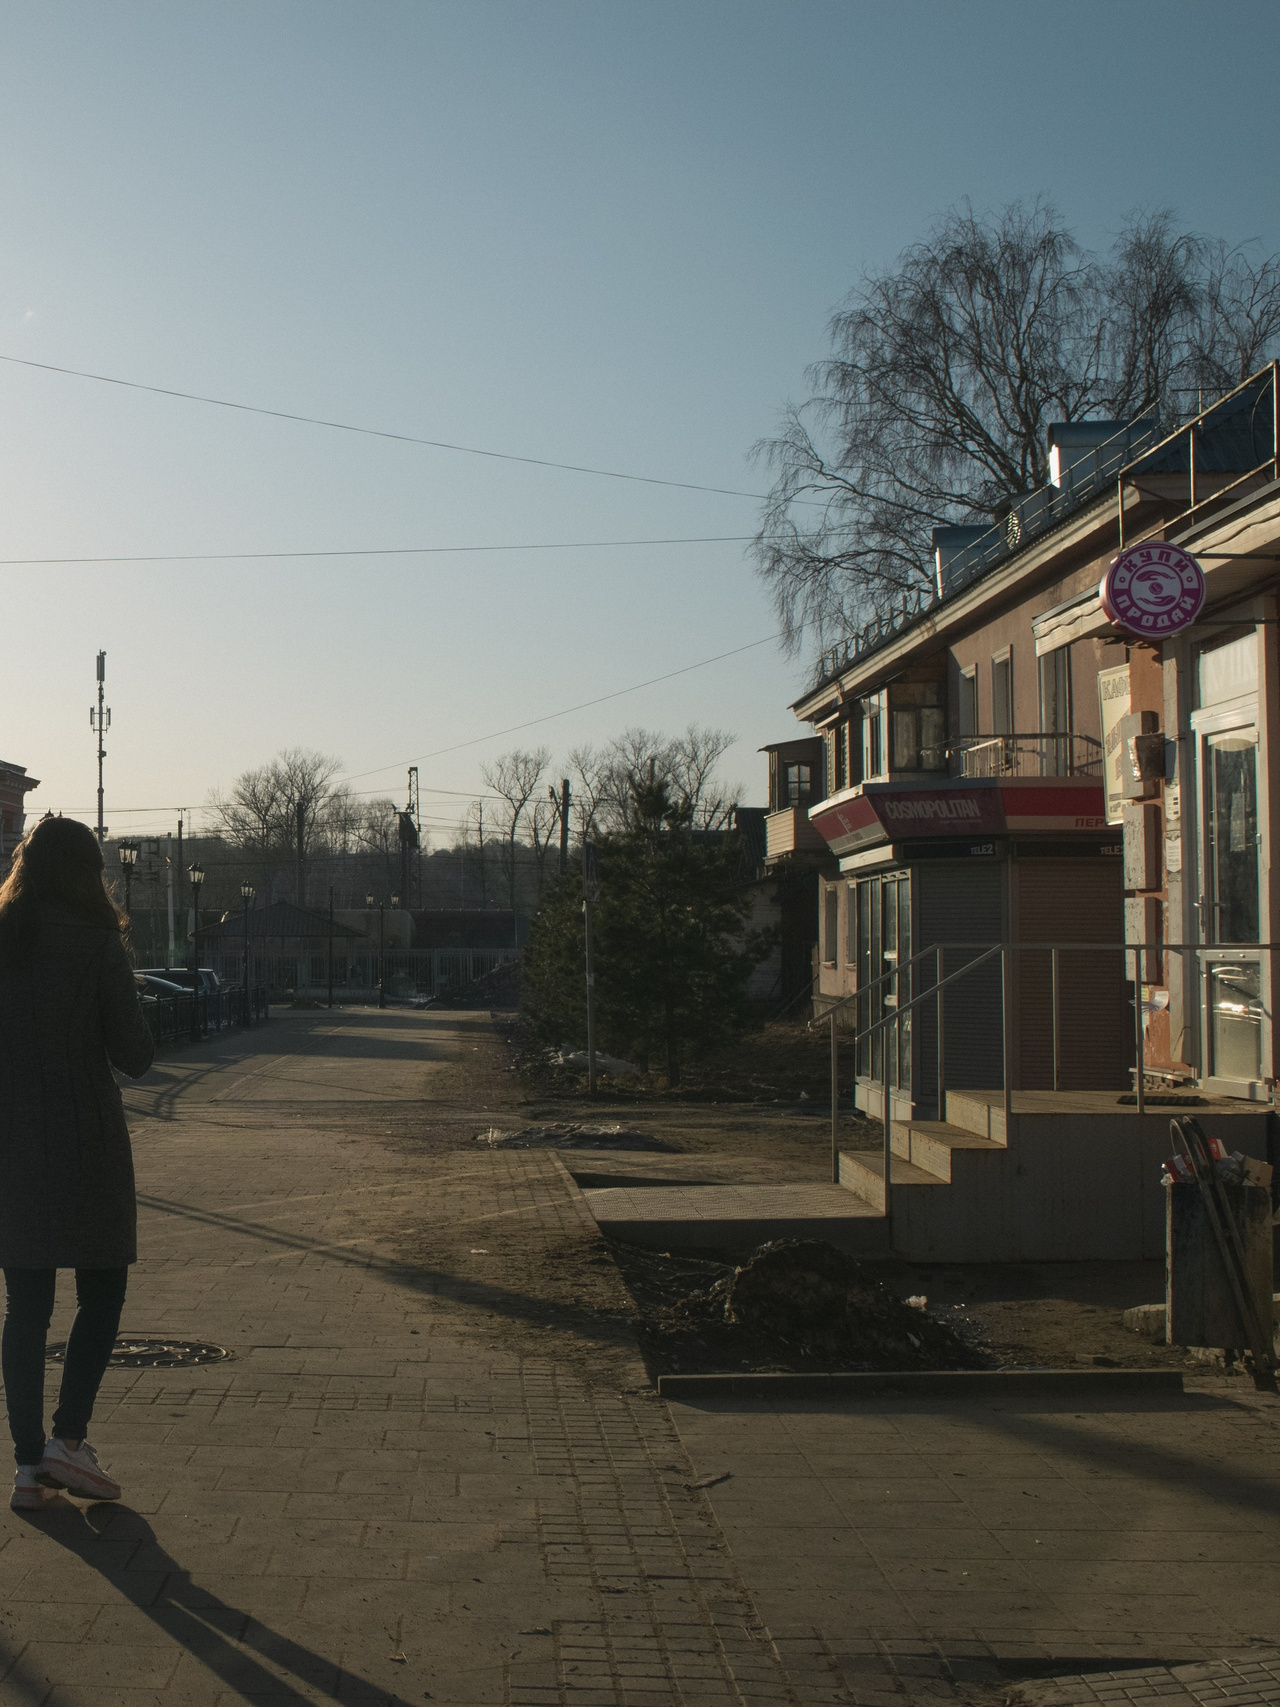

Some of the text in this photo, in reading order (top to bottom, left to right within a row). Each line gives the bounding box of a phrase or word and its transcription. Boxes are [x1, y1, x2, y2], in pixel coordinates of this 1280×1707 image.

[1122, 550, 1190, 574] КУПИ
[1116, 595, 1196, 628] ПРОДАЙ
[885, 798, 981, 819] COSMOPOLITAN
[1075, 818, 1109, 828] ПЕР
[970, 843, 994, 855] TELE2
